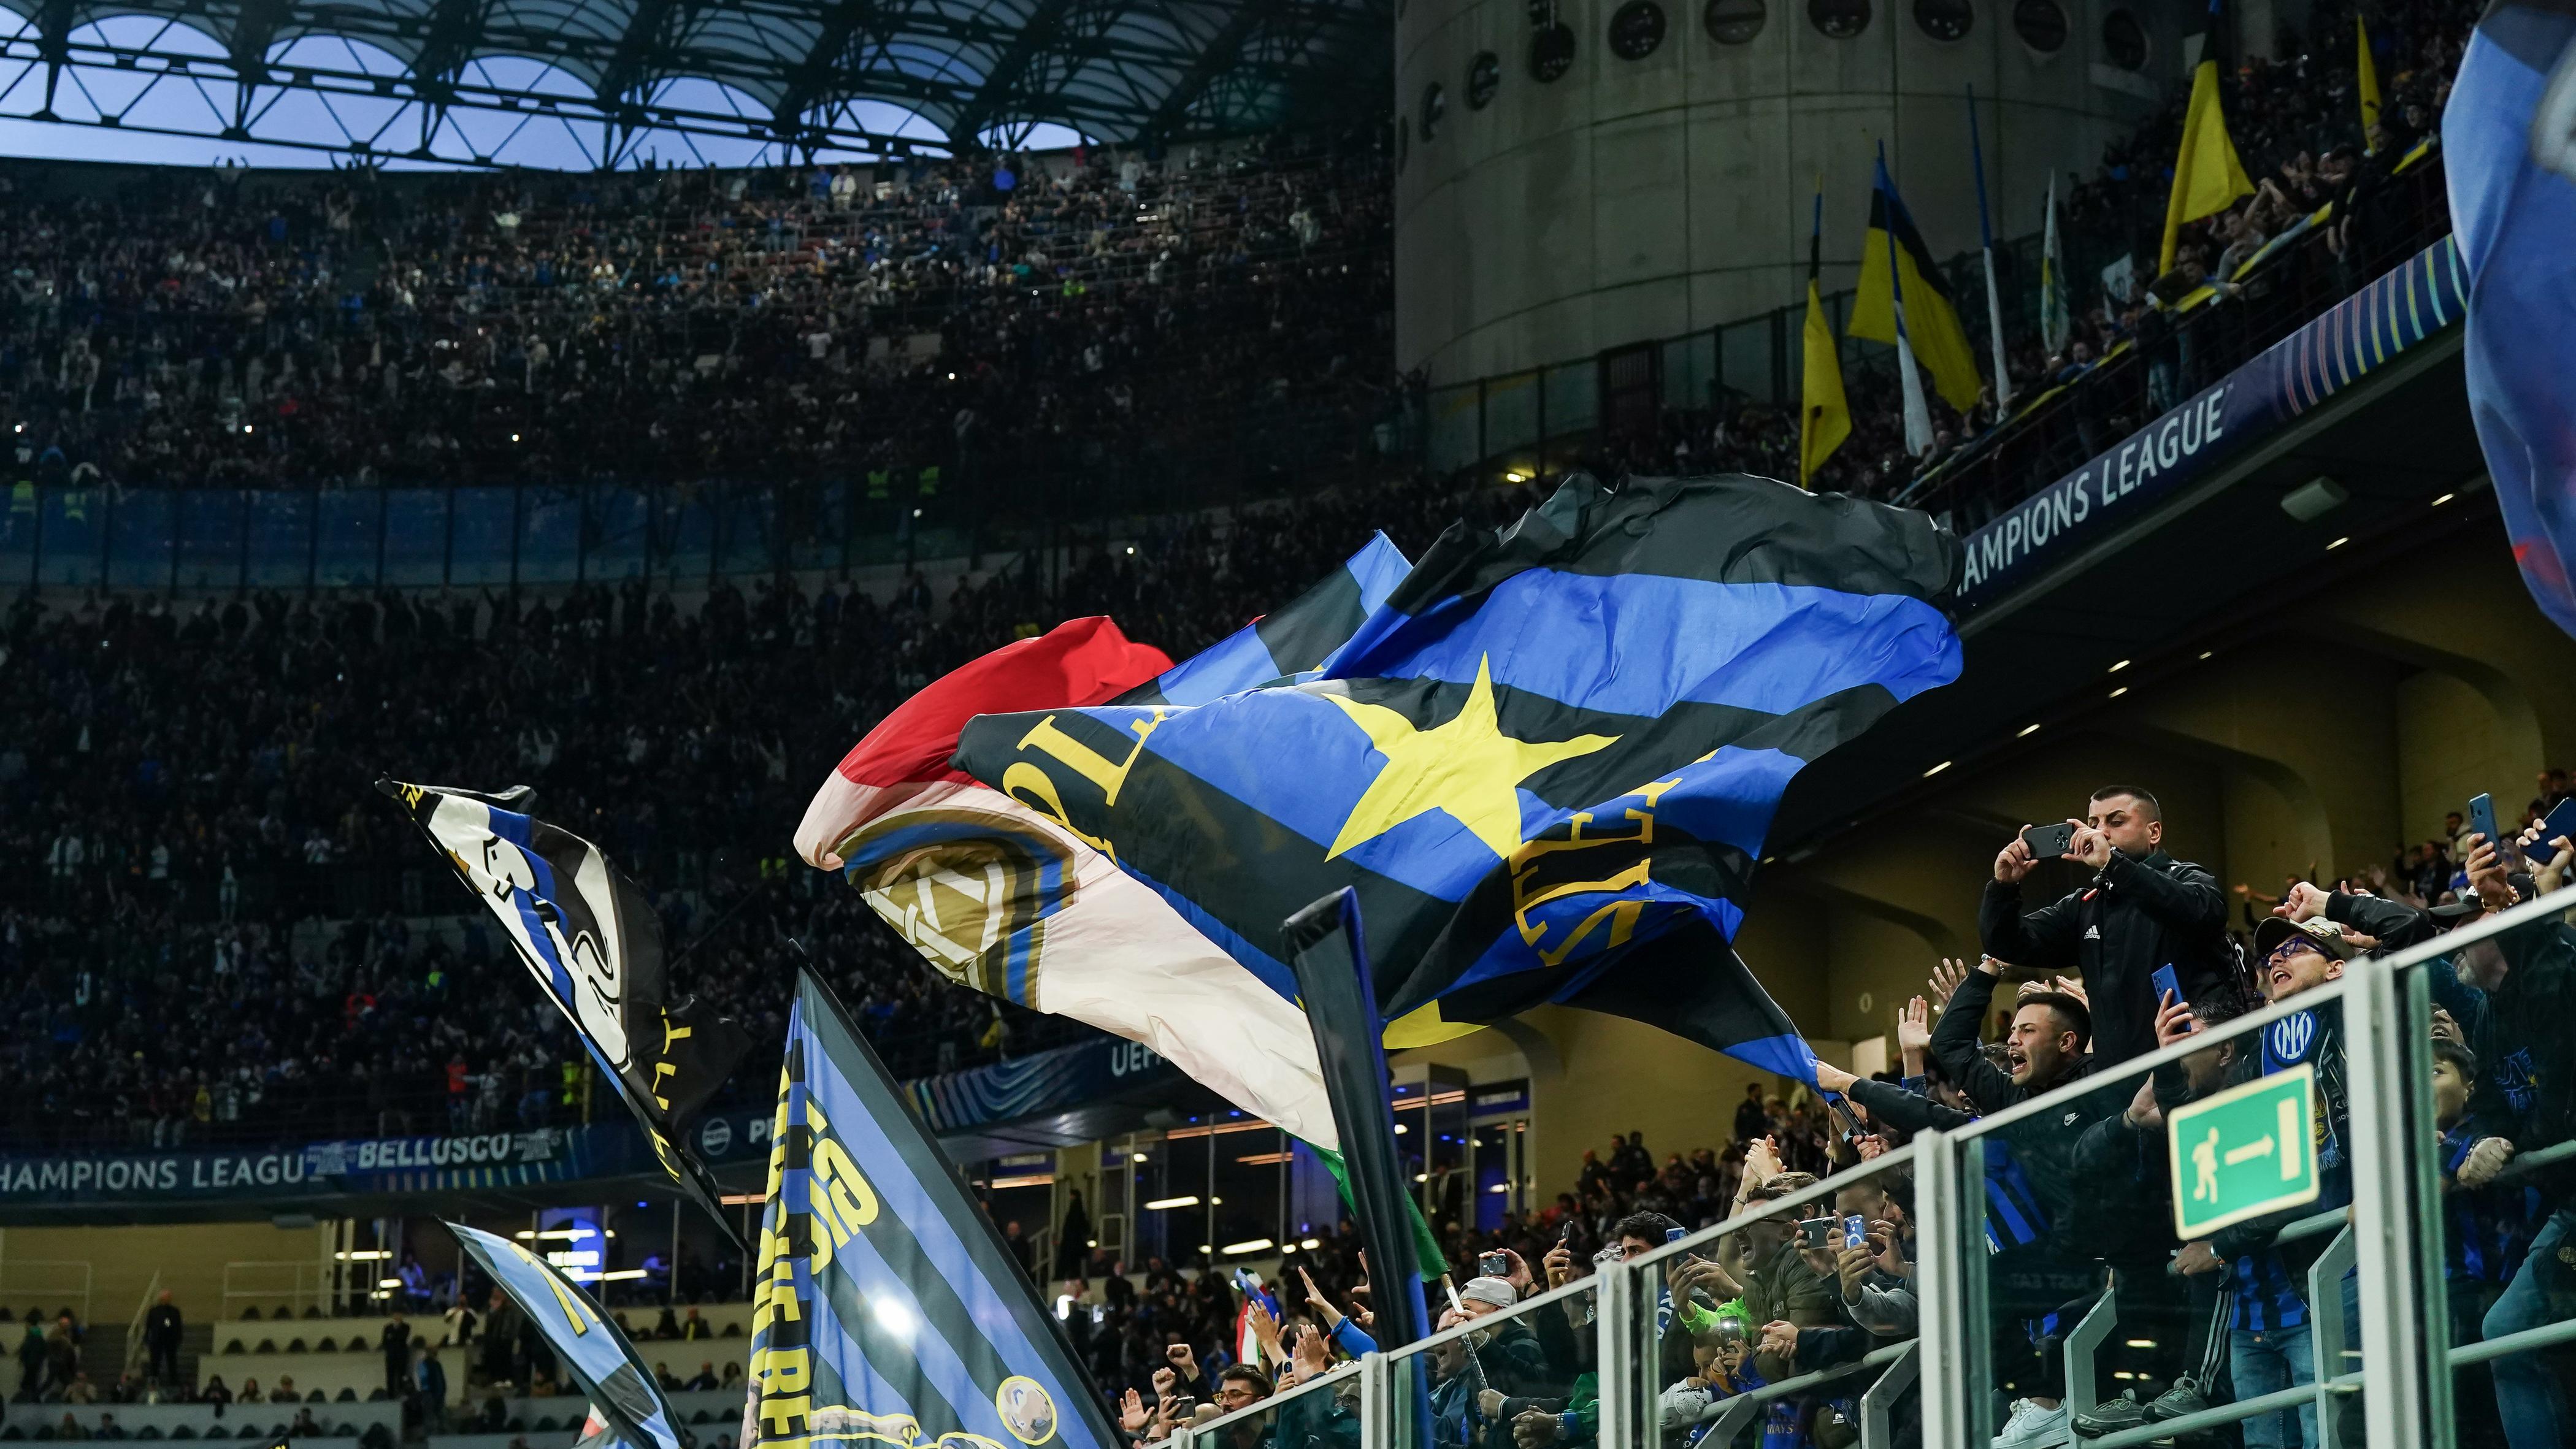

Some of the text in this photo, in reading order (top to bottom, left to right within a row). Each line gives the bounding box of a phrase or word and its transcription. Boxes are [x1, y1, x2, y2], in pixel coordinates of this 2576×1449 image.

[1957, 388, 2223, 597] AMPIONS LEAGUE
[1112, 1042, 1168, 1077] UEF
[2065, 1112, 2076, 1122] NIKE
[358, 1133, 512, 1169] BELLUSCO
[192, 1155, 326, 1186] LEAGU
